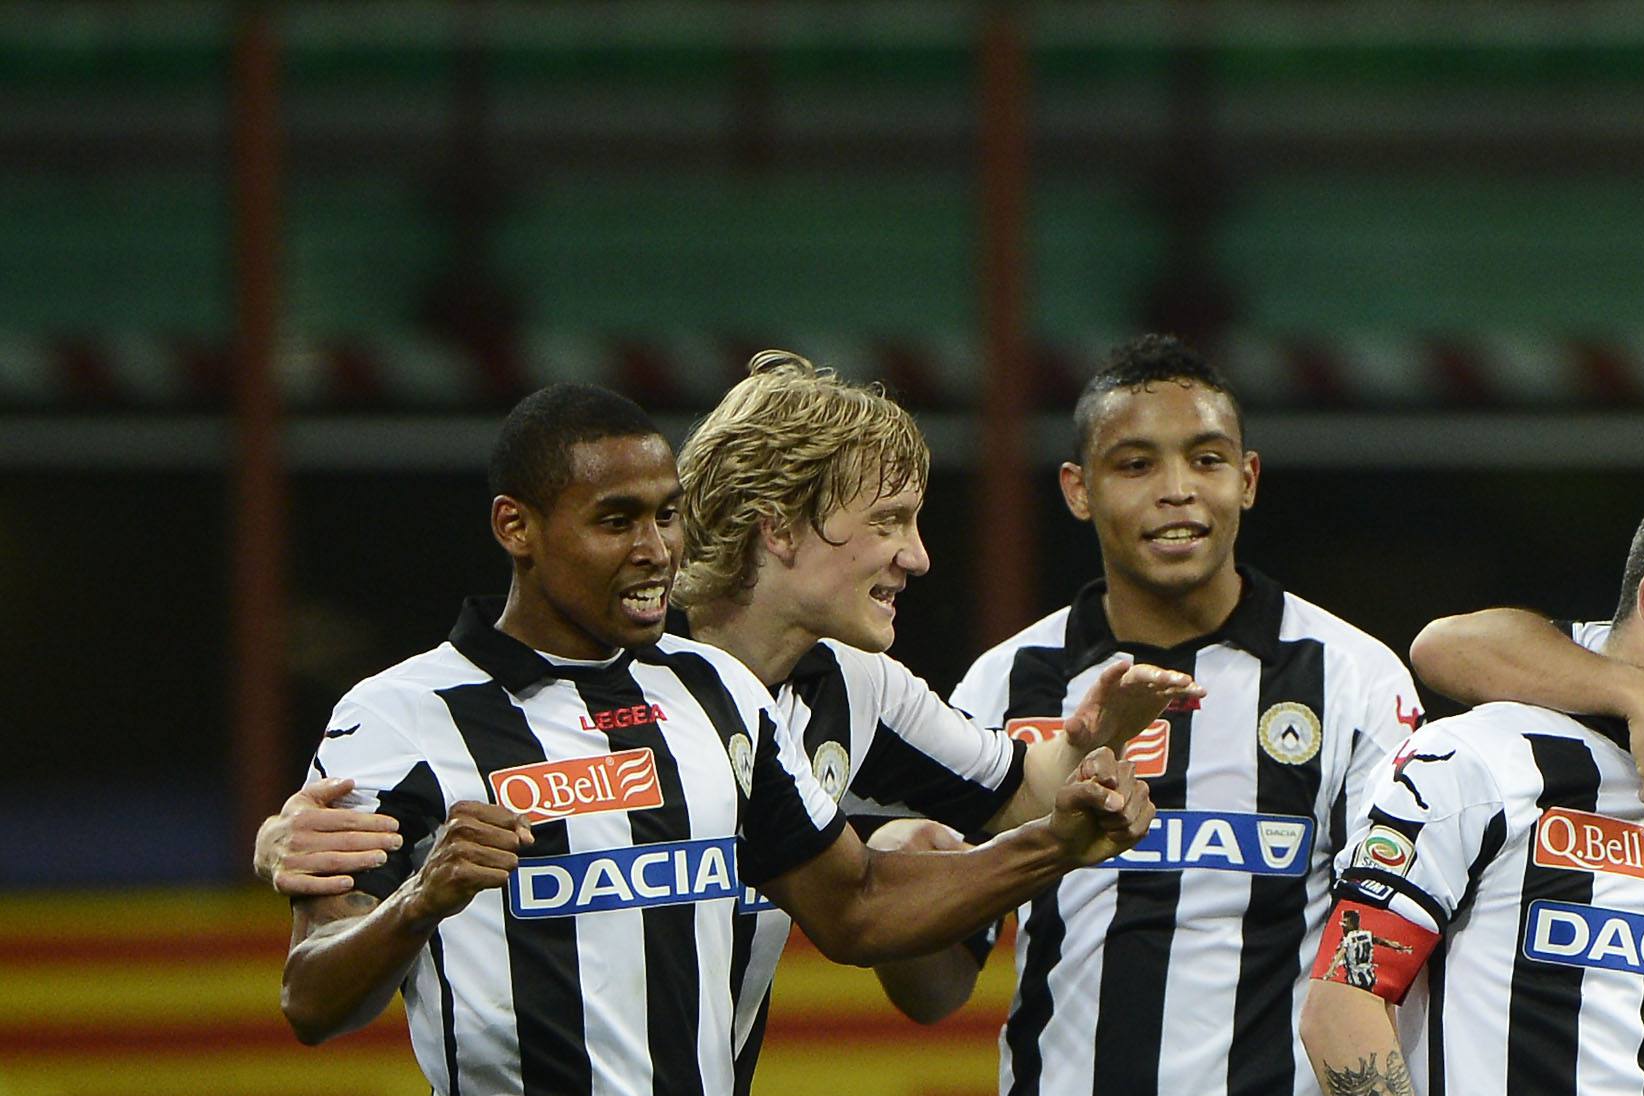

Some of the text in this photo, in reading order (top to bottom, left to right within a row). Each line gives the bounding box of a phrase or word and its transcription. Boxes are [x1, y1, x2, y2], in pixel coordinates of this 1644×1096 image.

[579, 703, 667, 731] LEGEA
[500, 764, 616, 816] Q.Bell
[1540, 815, 1644, 869] Q.Bell
[517, 847, 731, 910] DACIA
